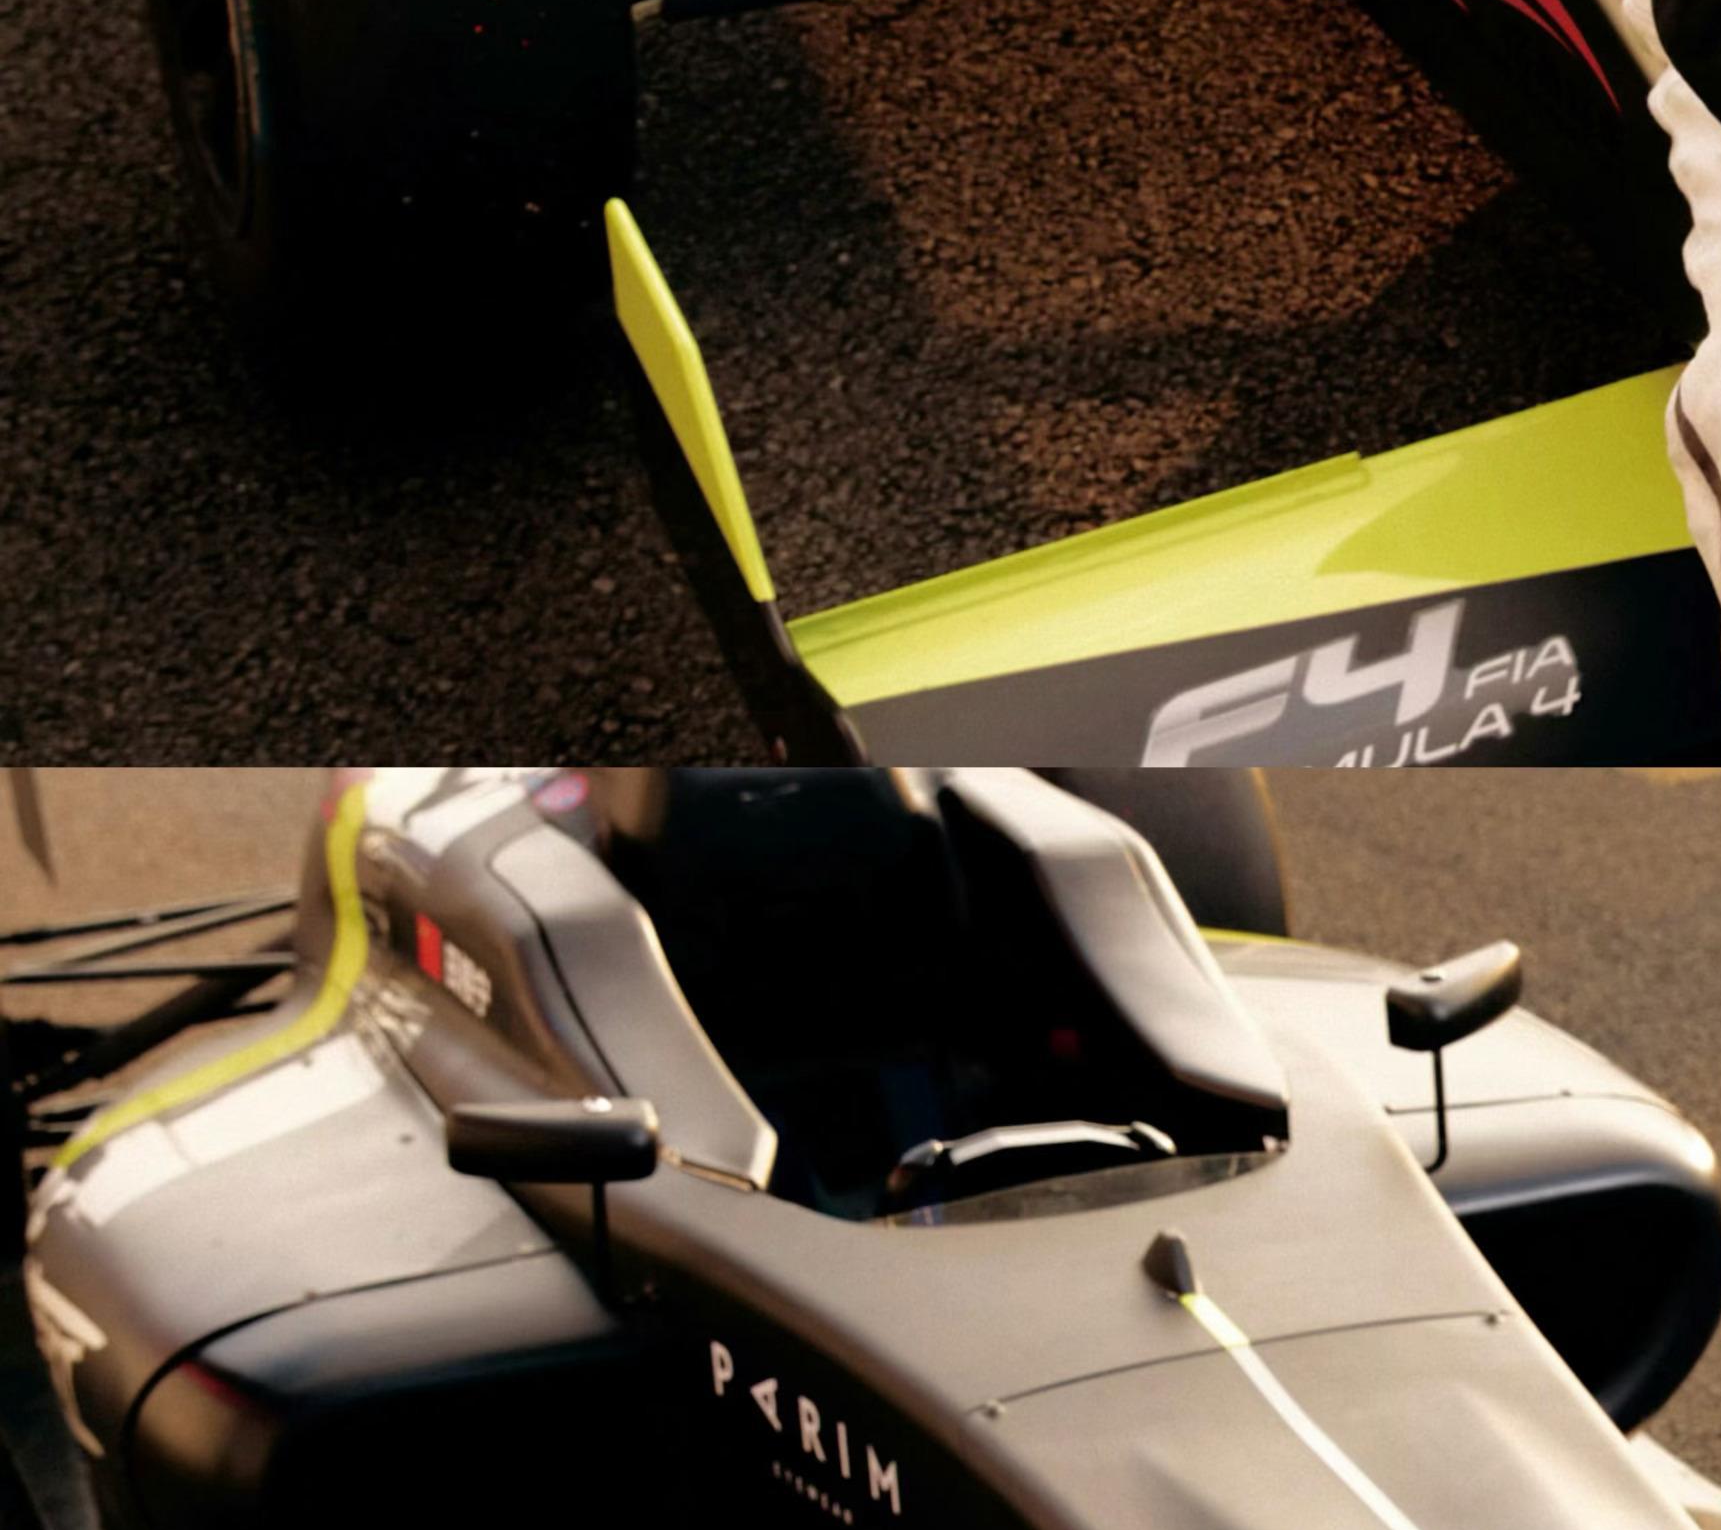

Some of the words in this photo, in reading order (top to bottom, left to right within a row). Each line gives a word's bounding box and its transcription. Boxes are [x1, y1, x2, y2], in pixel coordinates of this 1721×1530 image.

[1140, 597, 1465, 766] F4
[1464, 635, 1574, 700] FIA
[1530, 675, 1582, 716] 4
[709, 1339, 901, 1516] PARIM
